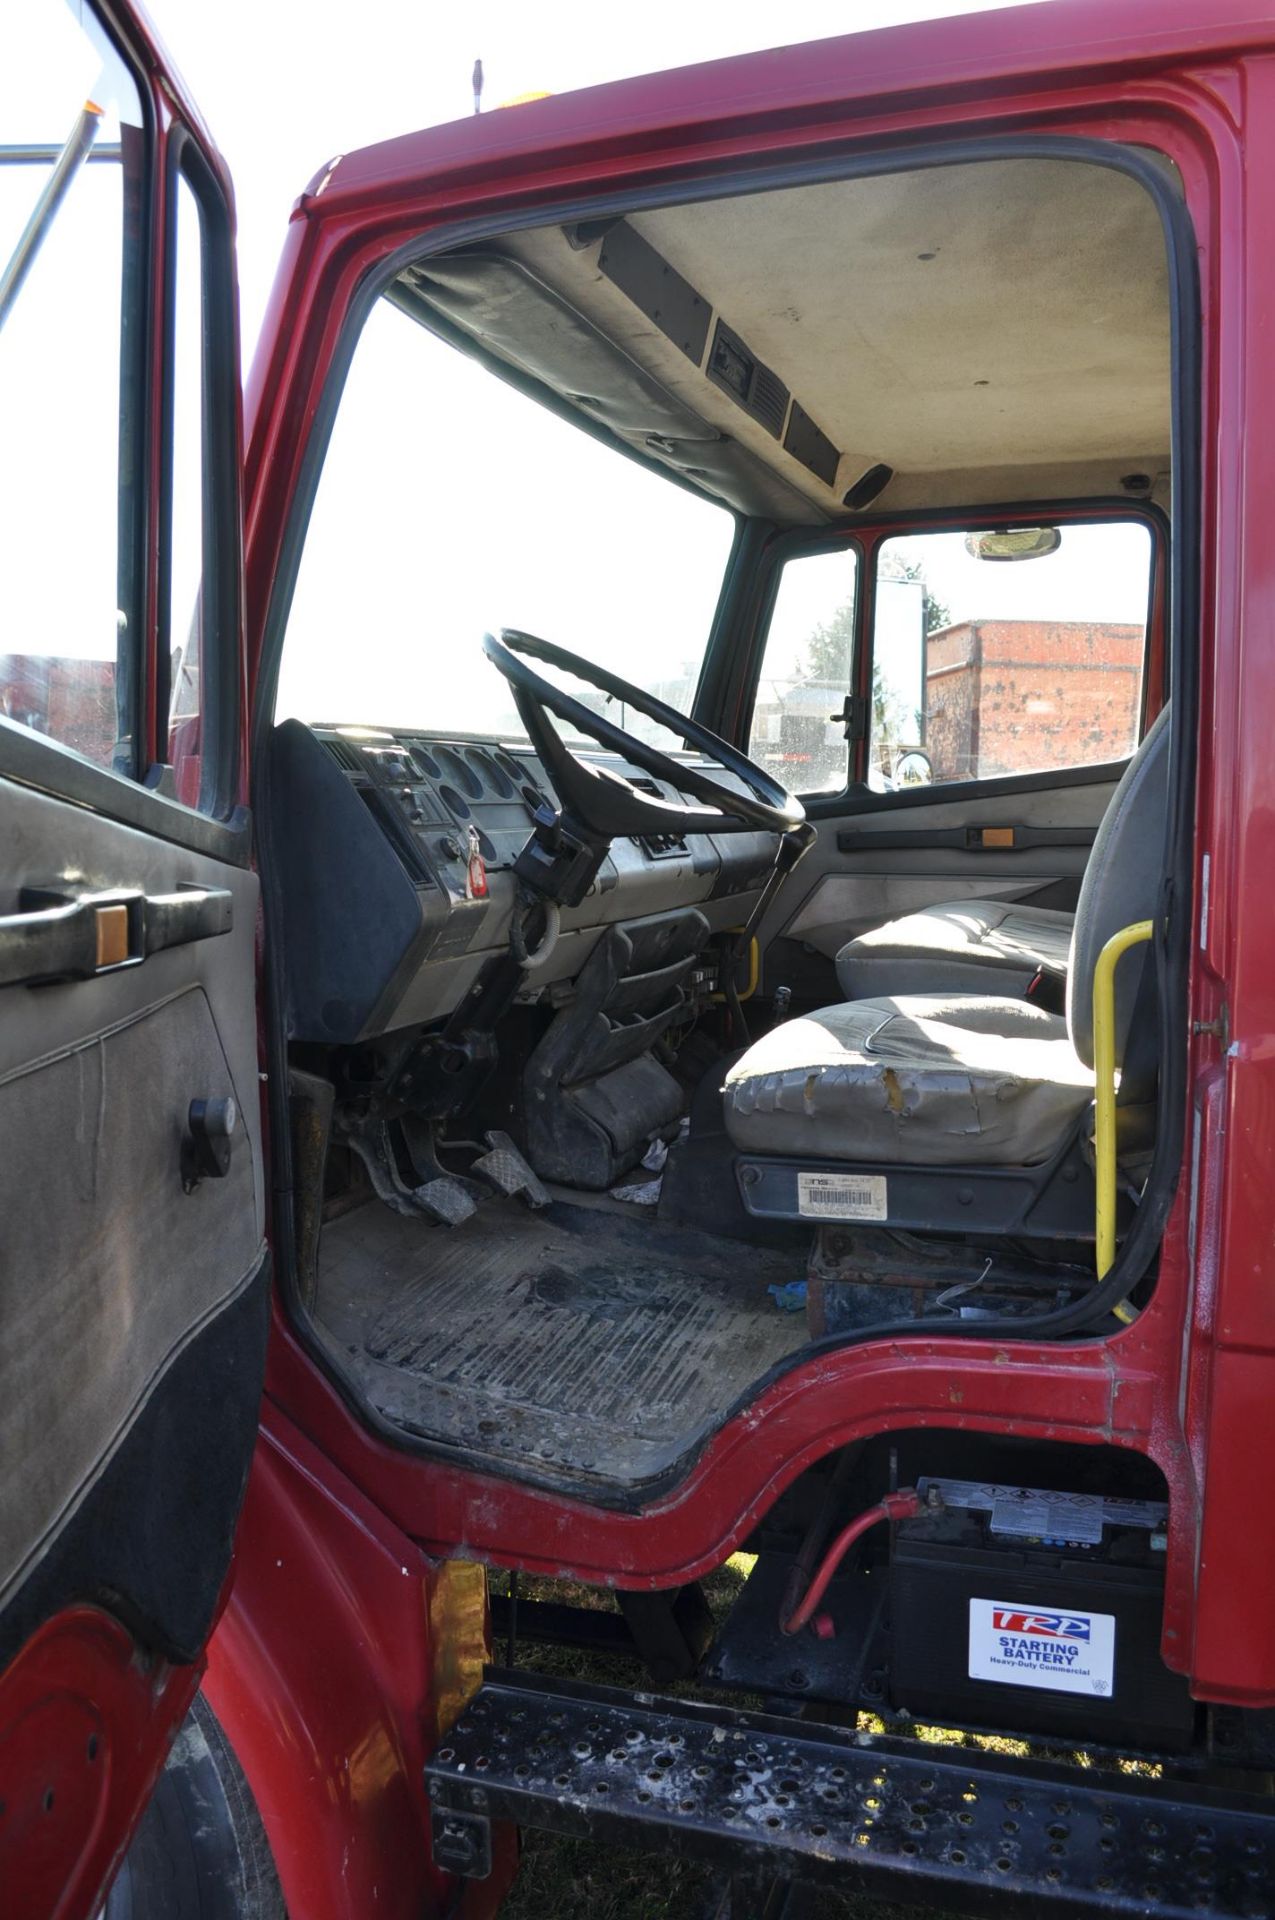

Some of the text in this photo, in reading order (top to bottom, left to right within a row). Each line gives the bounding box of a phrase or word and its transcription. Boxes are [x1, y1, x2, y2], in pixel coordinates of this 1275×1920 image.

[993, 1609, 1090, 1637] TRP
[999, 1637, 1079, 1656] STARTING
[989, 1657, 1090, 1676] Heavy-Duty Commercial
[1003, 1648, 1075, 1666] BATTERY
